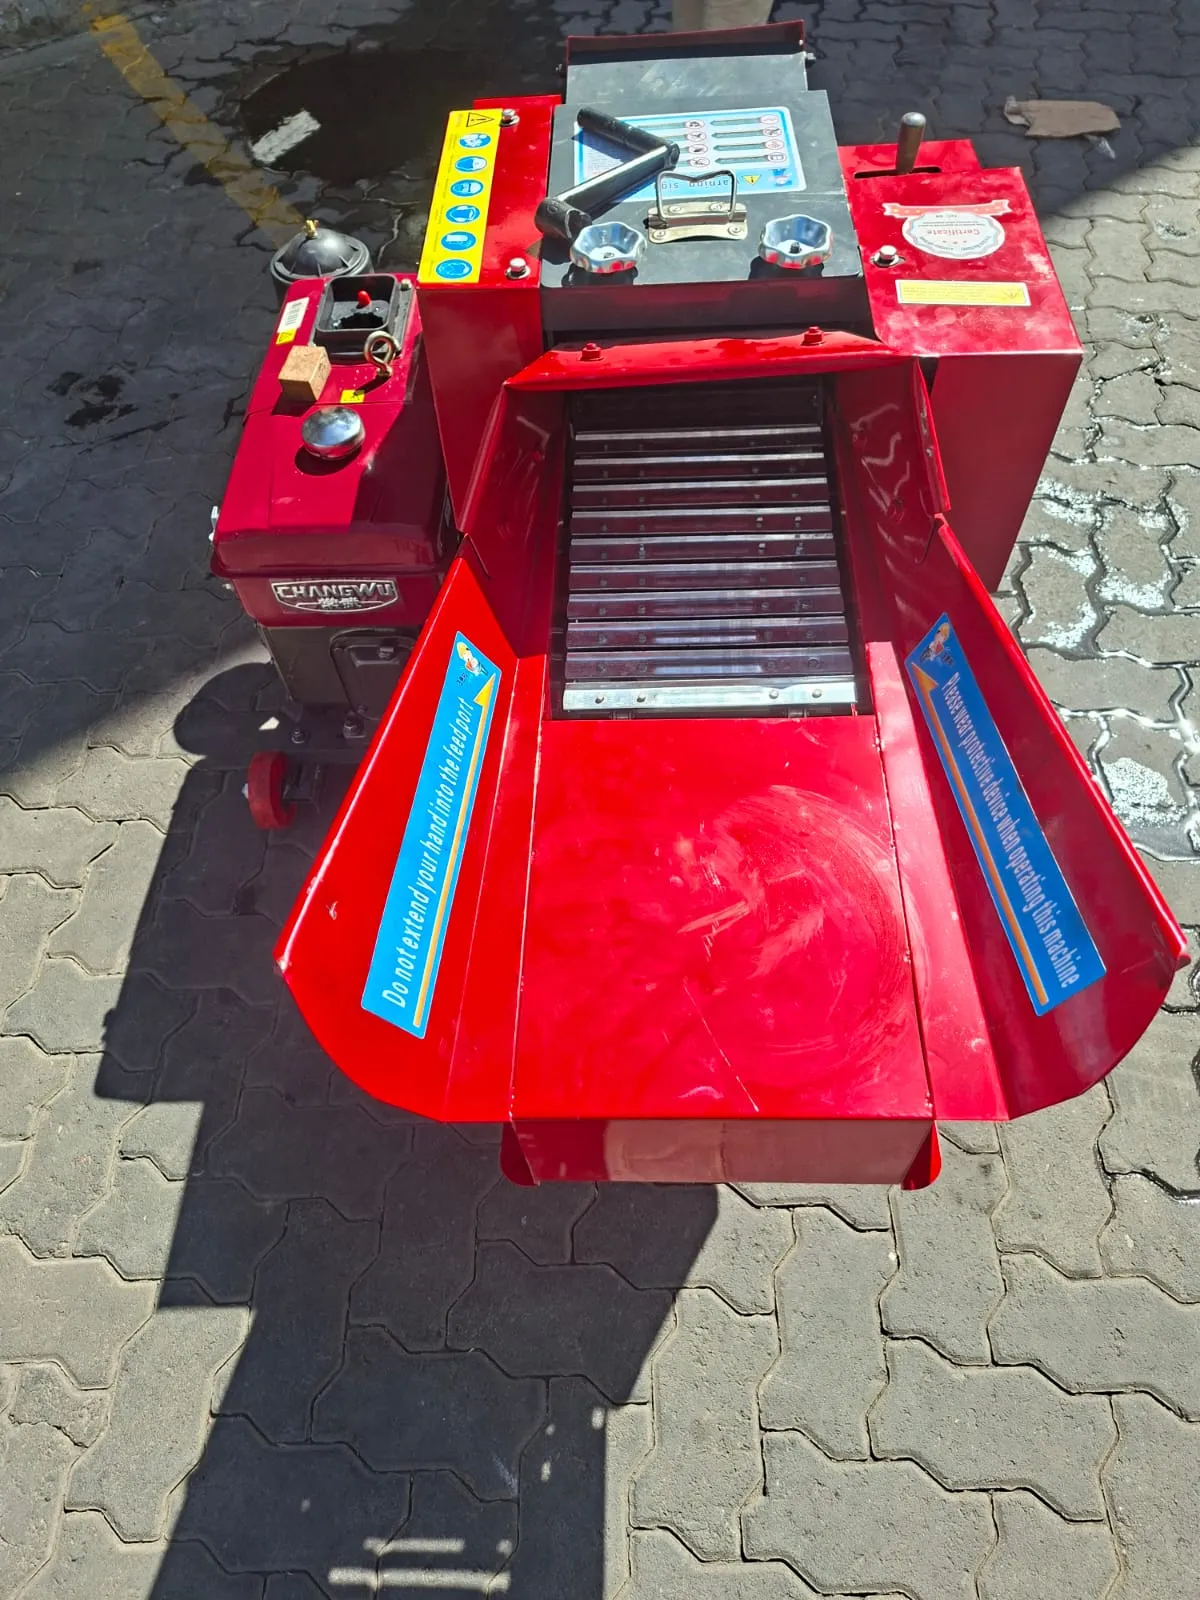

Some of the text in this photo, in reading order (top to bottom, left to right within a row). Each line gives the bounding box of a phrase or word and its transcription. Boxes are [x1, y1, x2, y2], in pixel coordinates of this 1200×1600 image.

[688, 178, 739, 189] arning
[276, 582, 391, 598] CHANGWU
[942, 671, 964, 715] Please
[455, 695, 474, 736] port
[953, 705, 974, 738] wear
[442, 722, 467, 762] feed
[957, 730, 996, 788] protective
[438, 757, 460, 786] the
[430, 782, 455, 817] into
[983, 777, 1010, 822] device
[419, 809, 448, 856] hand
[996, 813, 1020, 852] when
[416, 850, 438, 894] your
[1005, 845, 1046, 913] operating
[402, 885, 430, 950] extend
[1032, 900, 1061, 934] this
[395, 946, 416, 982] not
[1042, 927, 1082, 988] machine
[381, 980, 409, 1009] Do
